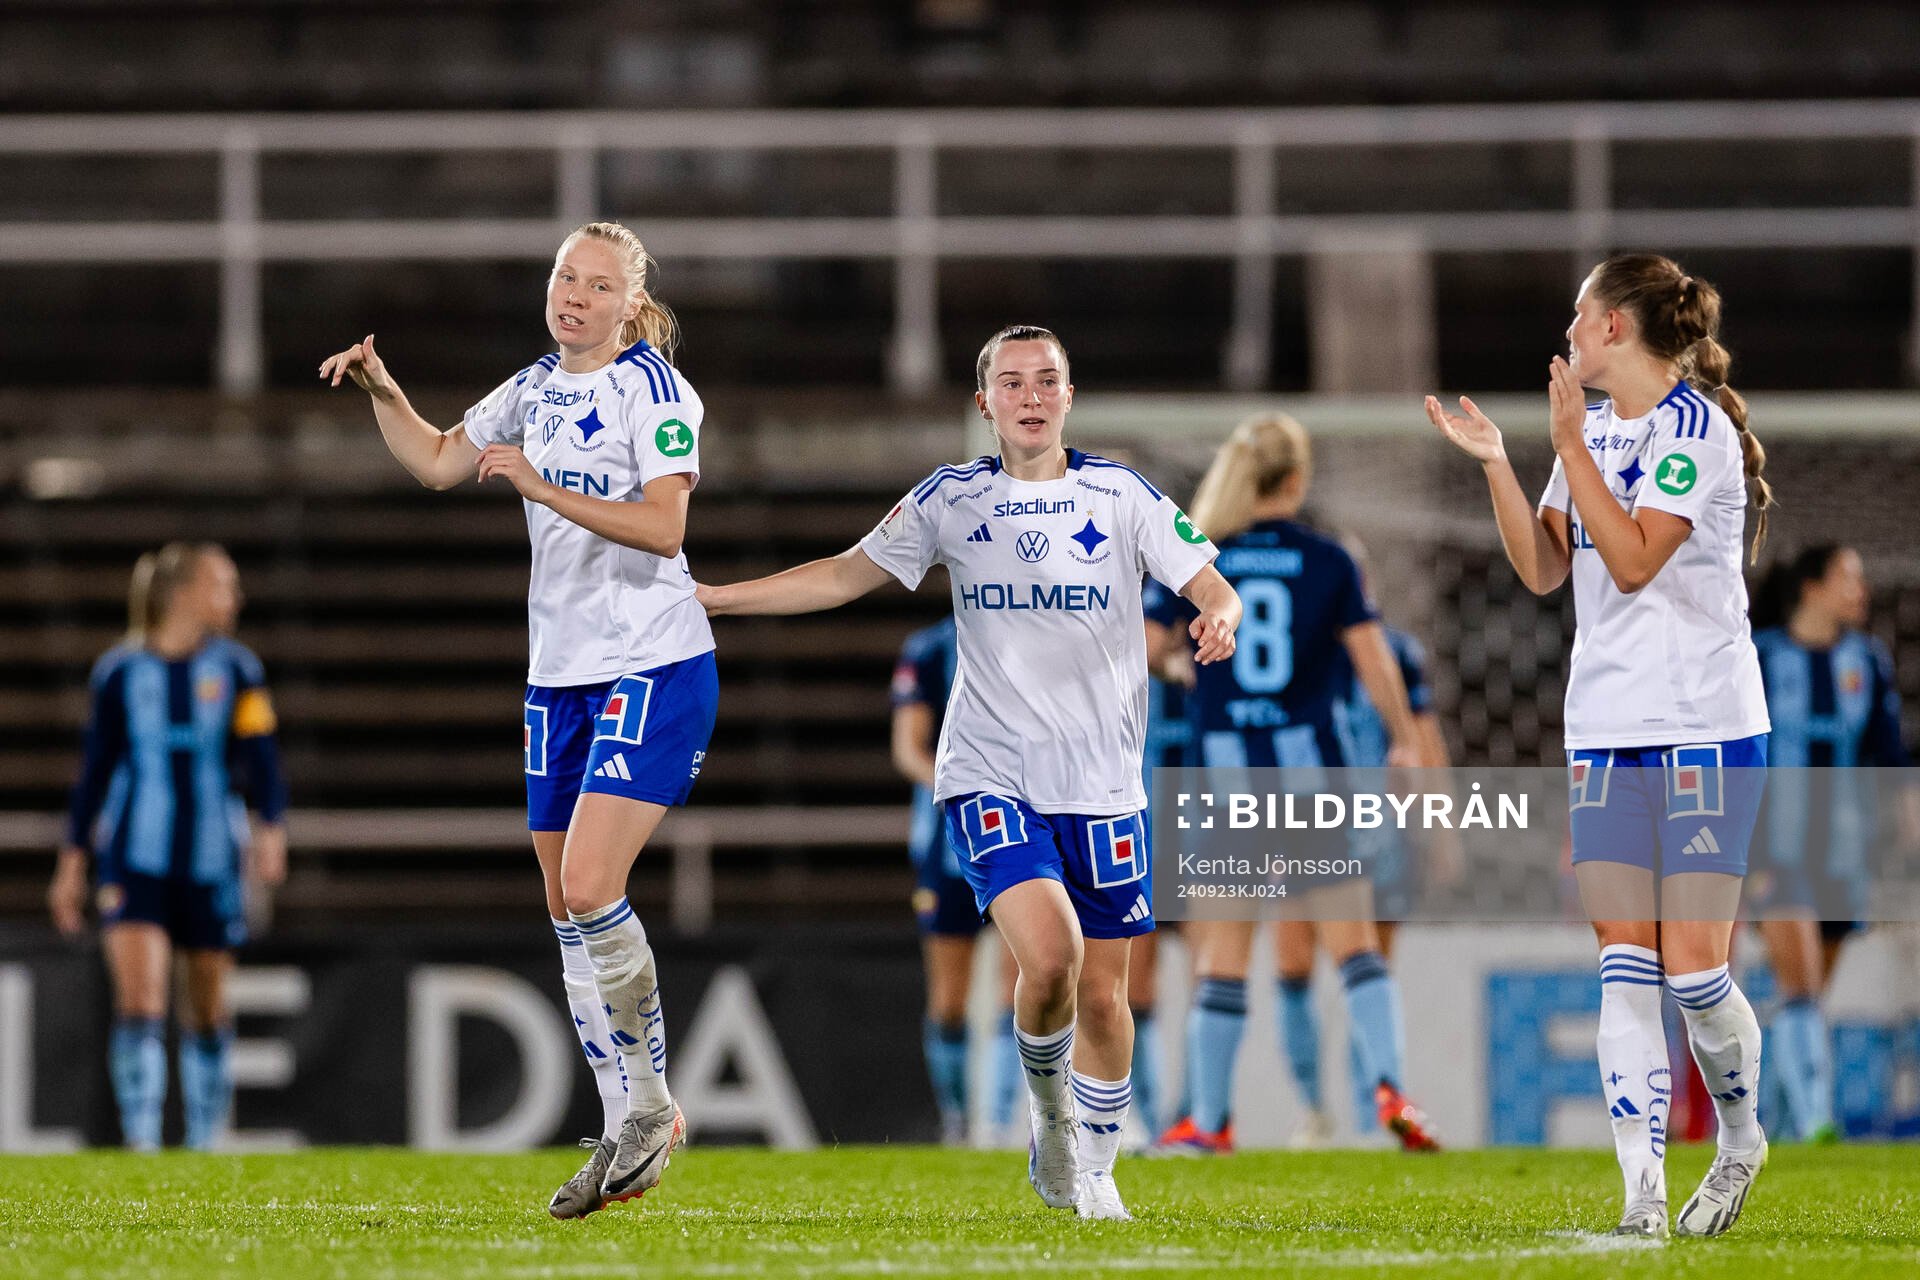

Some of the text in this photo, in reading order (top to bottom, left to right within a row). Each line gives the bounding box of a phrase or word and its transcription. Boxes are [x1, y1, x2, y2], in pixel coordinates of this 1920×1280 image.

[993, 498, 1075, 517] stadium
[960, 583, 1111, 610] HOLMEN
[1233, 578, 1294, 694] 8
